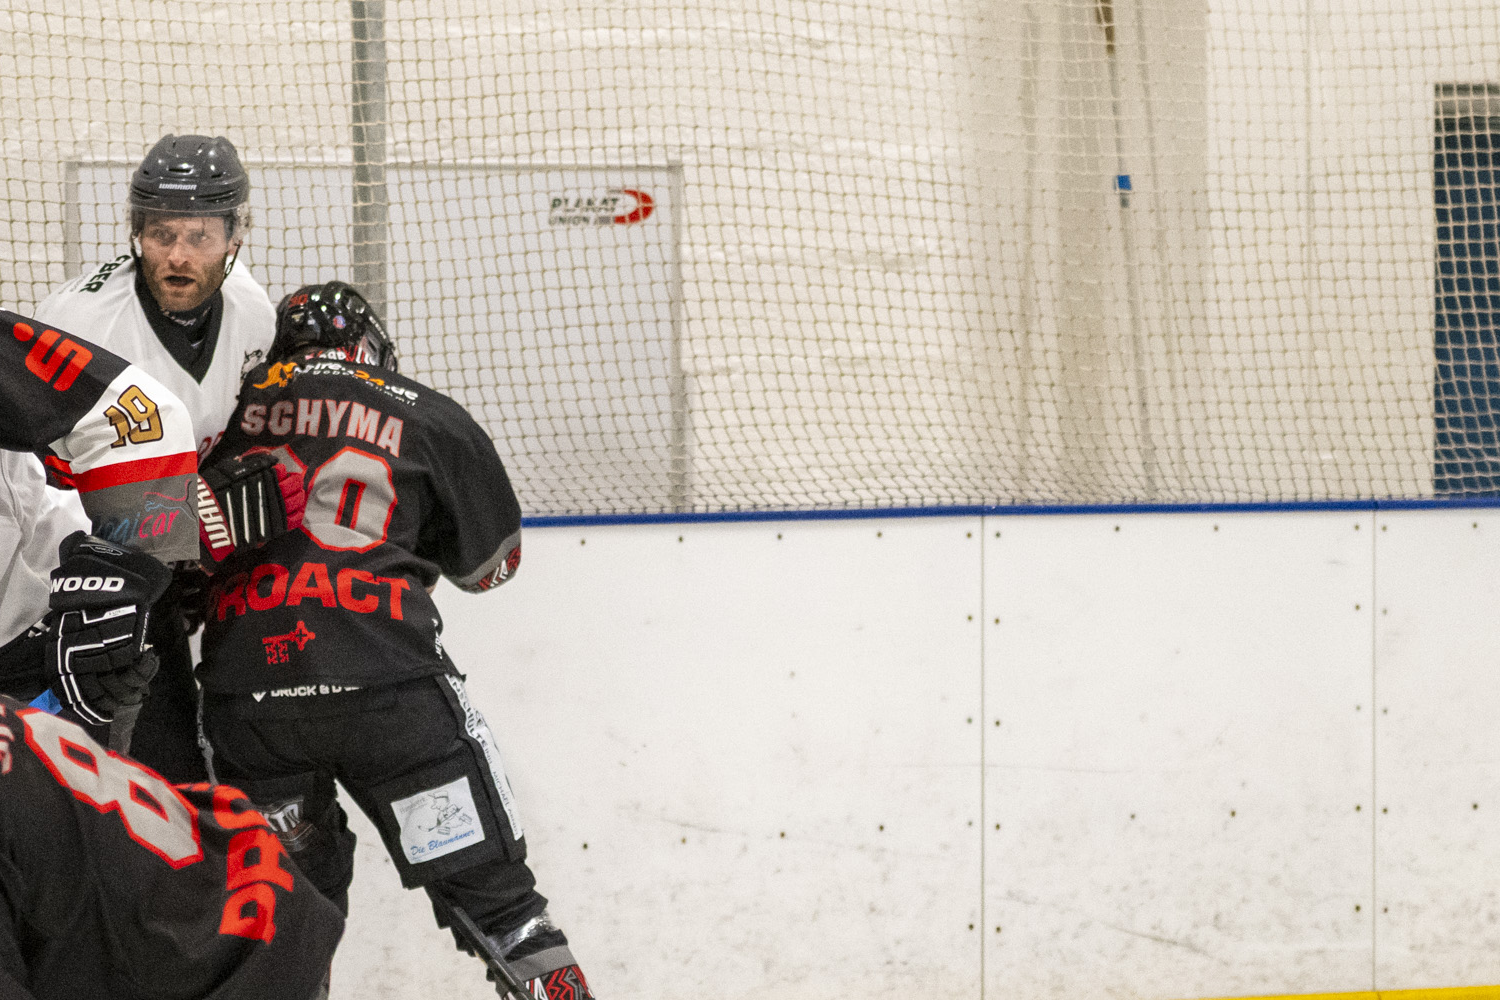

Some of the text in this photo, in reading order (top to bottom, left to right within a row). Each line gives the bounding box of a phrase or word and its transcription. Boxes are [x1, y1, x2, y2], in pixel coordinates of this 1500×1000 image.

[159, 182, 197, 191] WARRIOR
[241, 398, 404, 458] SCHYMA
[204, 562, 410, 622] ROACT
[15, 707, 204, 870] 8
